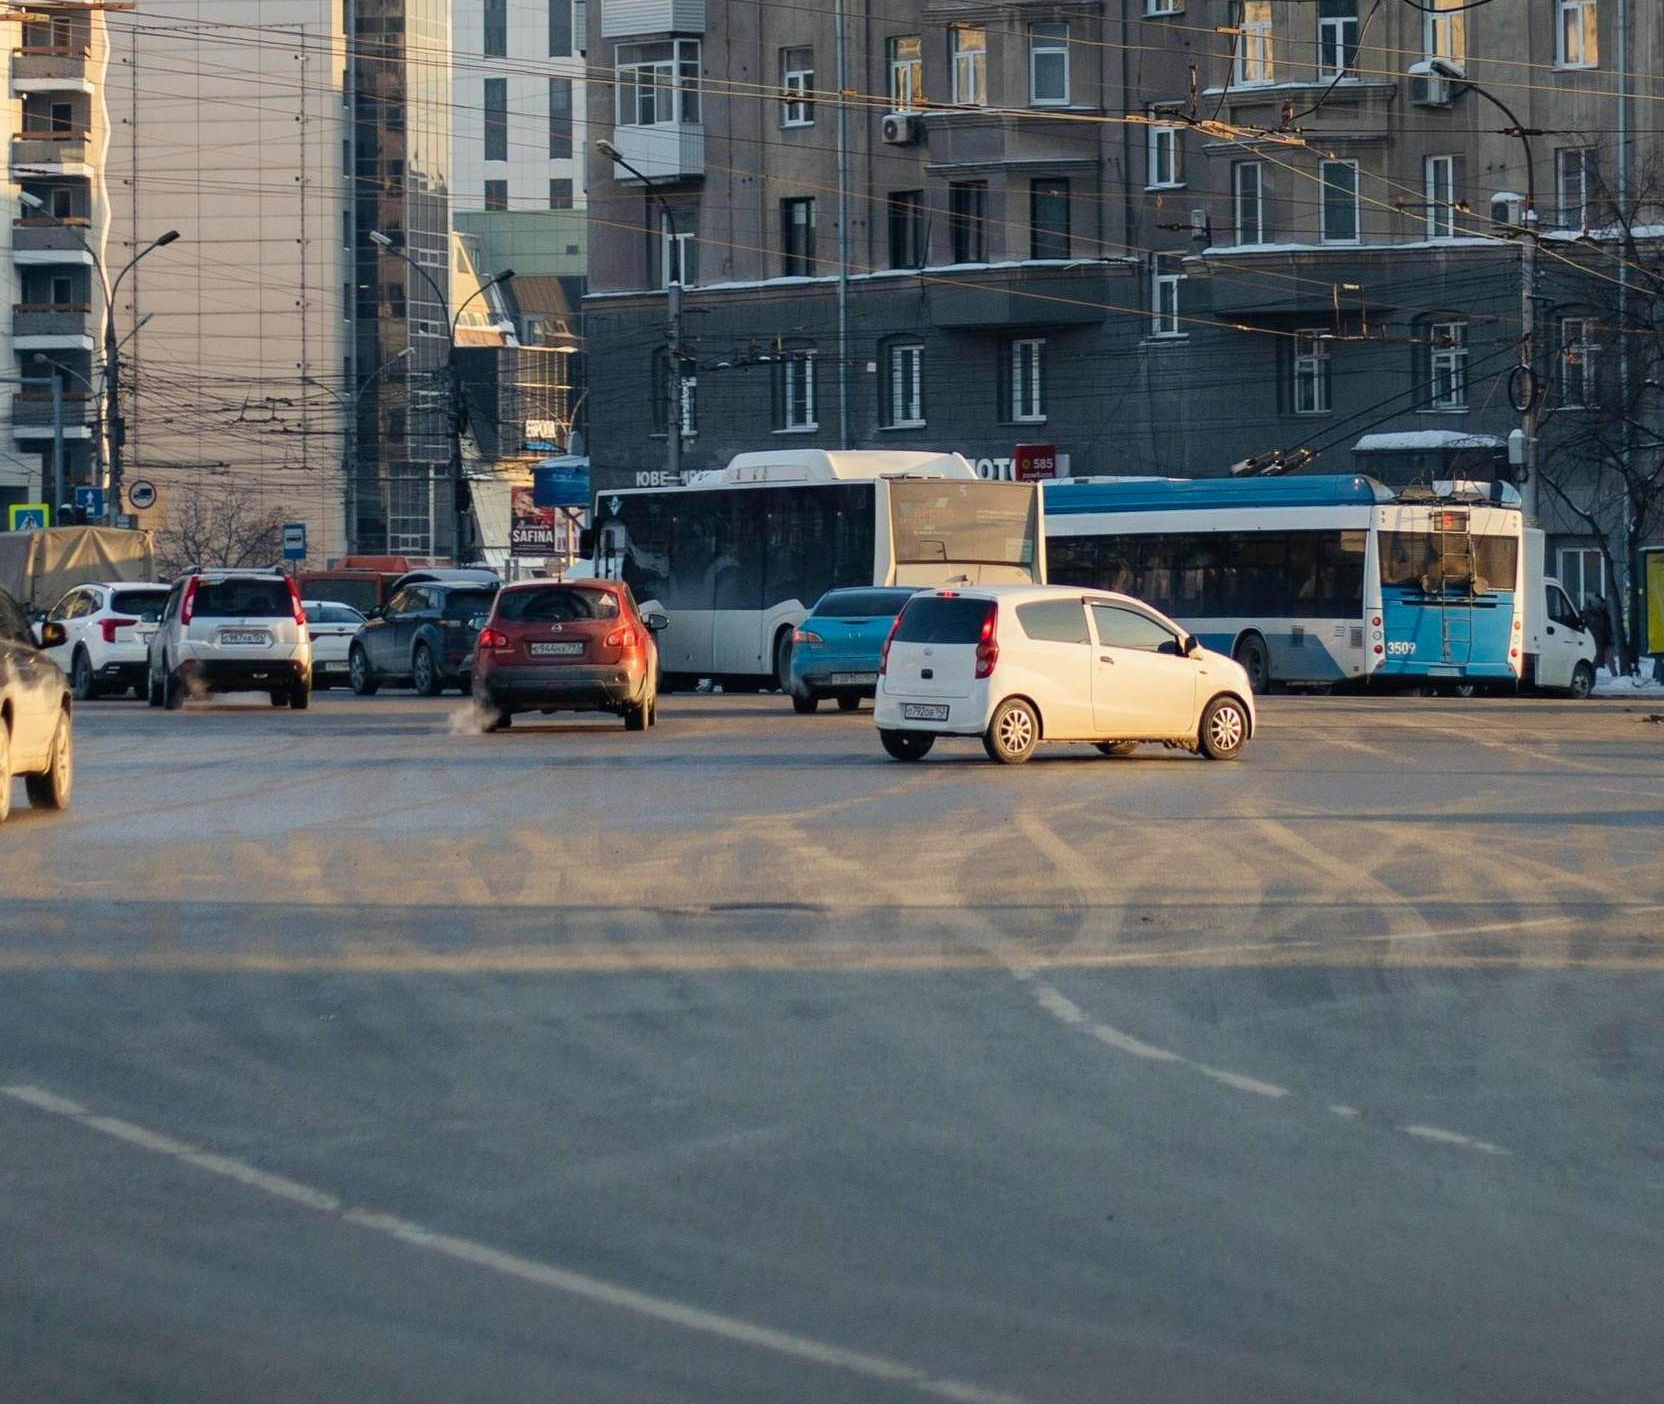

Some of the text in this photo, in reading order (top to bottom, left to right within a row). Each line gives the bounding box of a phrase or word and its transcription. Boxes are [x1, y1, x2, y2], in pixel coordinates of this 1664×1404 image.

[1033, 458, 1054, 469] 585
[512, 529, 554, 543] SAFINA
[1386, 641, 1417, 655] 3509
